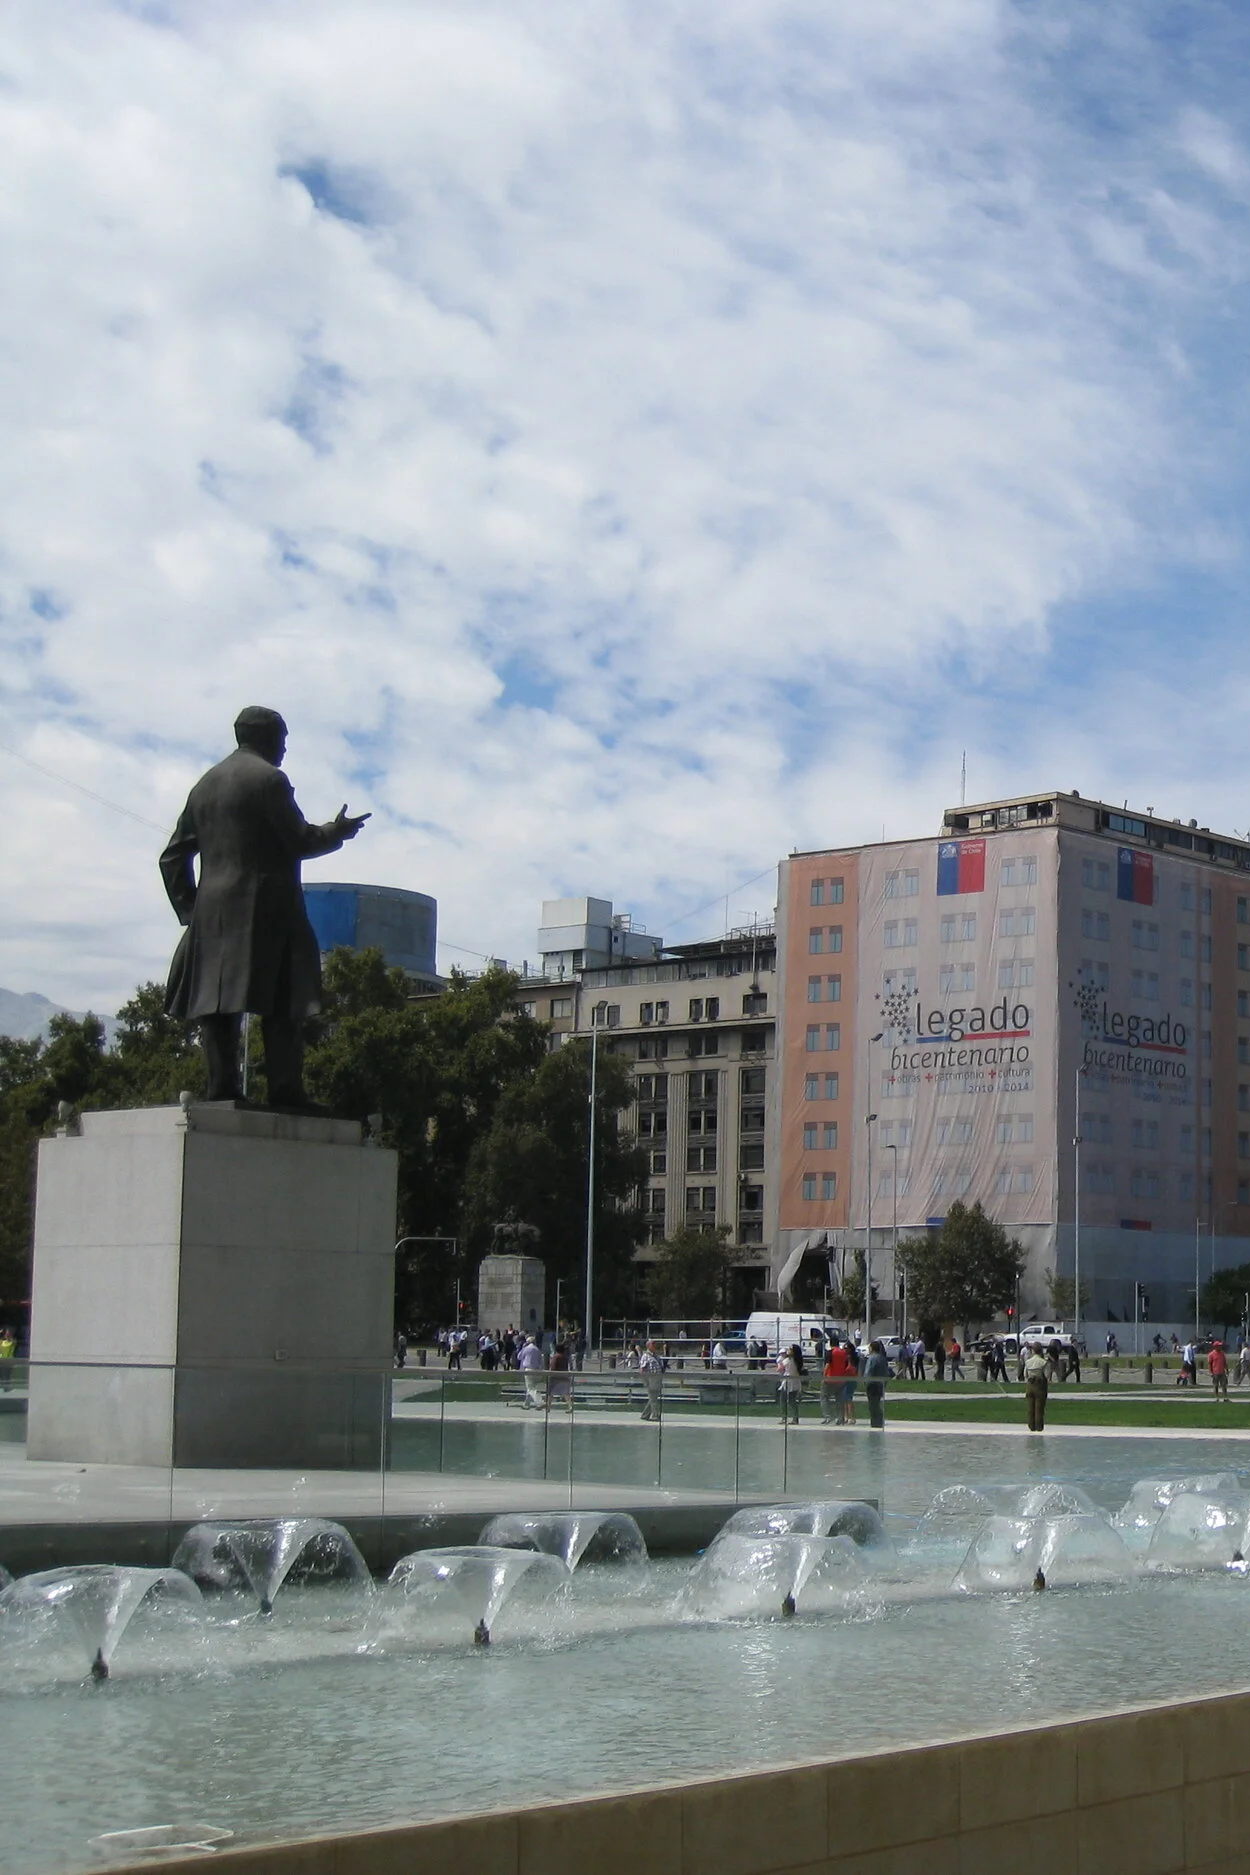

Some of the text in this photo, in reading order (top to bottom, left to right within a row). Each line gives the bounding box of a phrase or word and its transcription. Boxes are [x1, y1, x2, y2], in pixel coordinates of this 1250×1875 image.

[916, 996, 1030, 1042] legado
[1103, 1001, 1186, 1048] legado
[891, 1046, 1030, 1070] bicentenario
[1083, 1041, 1186, 1078] bicentenario
[968, 1085, 994, 1094] 2010
[1004, 1083, 1029, 1093] 2014
